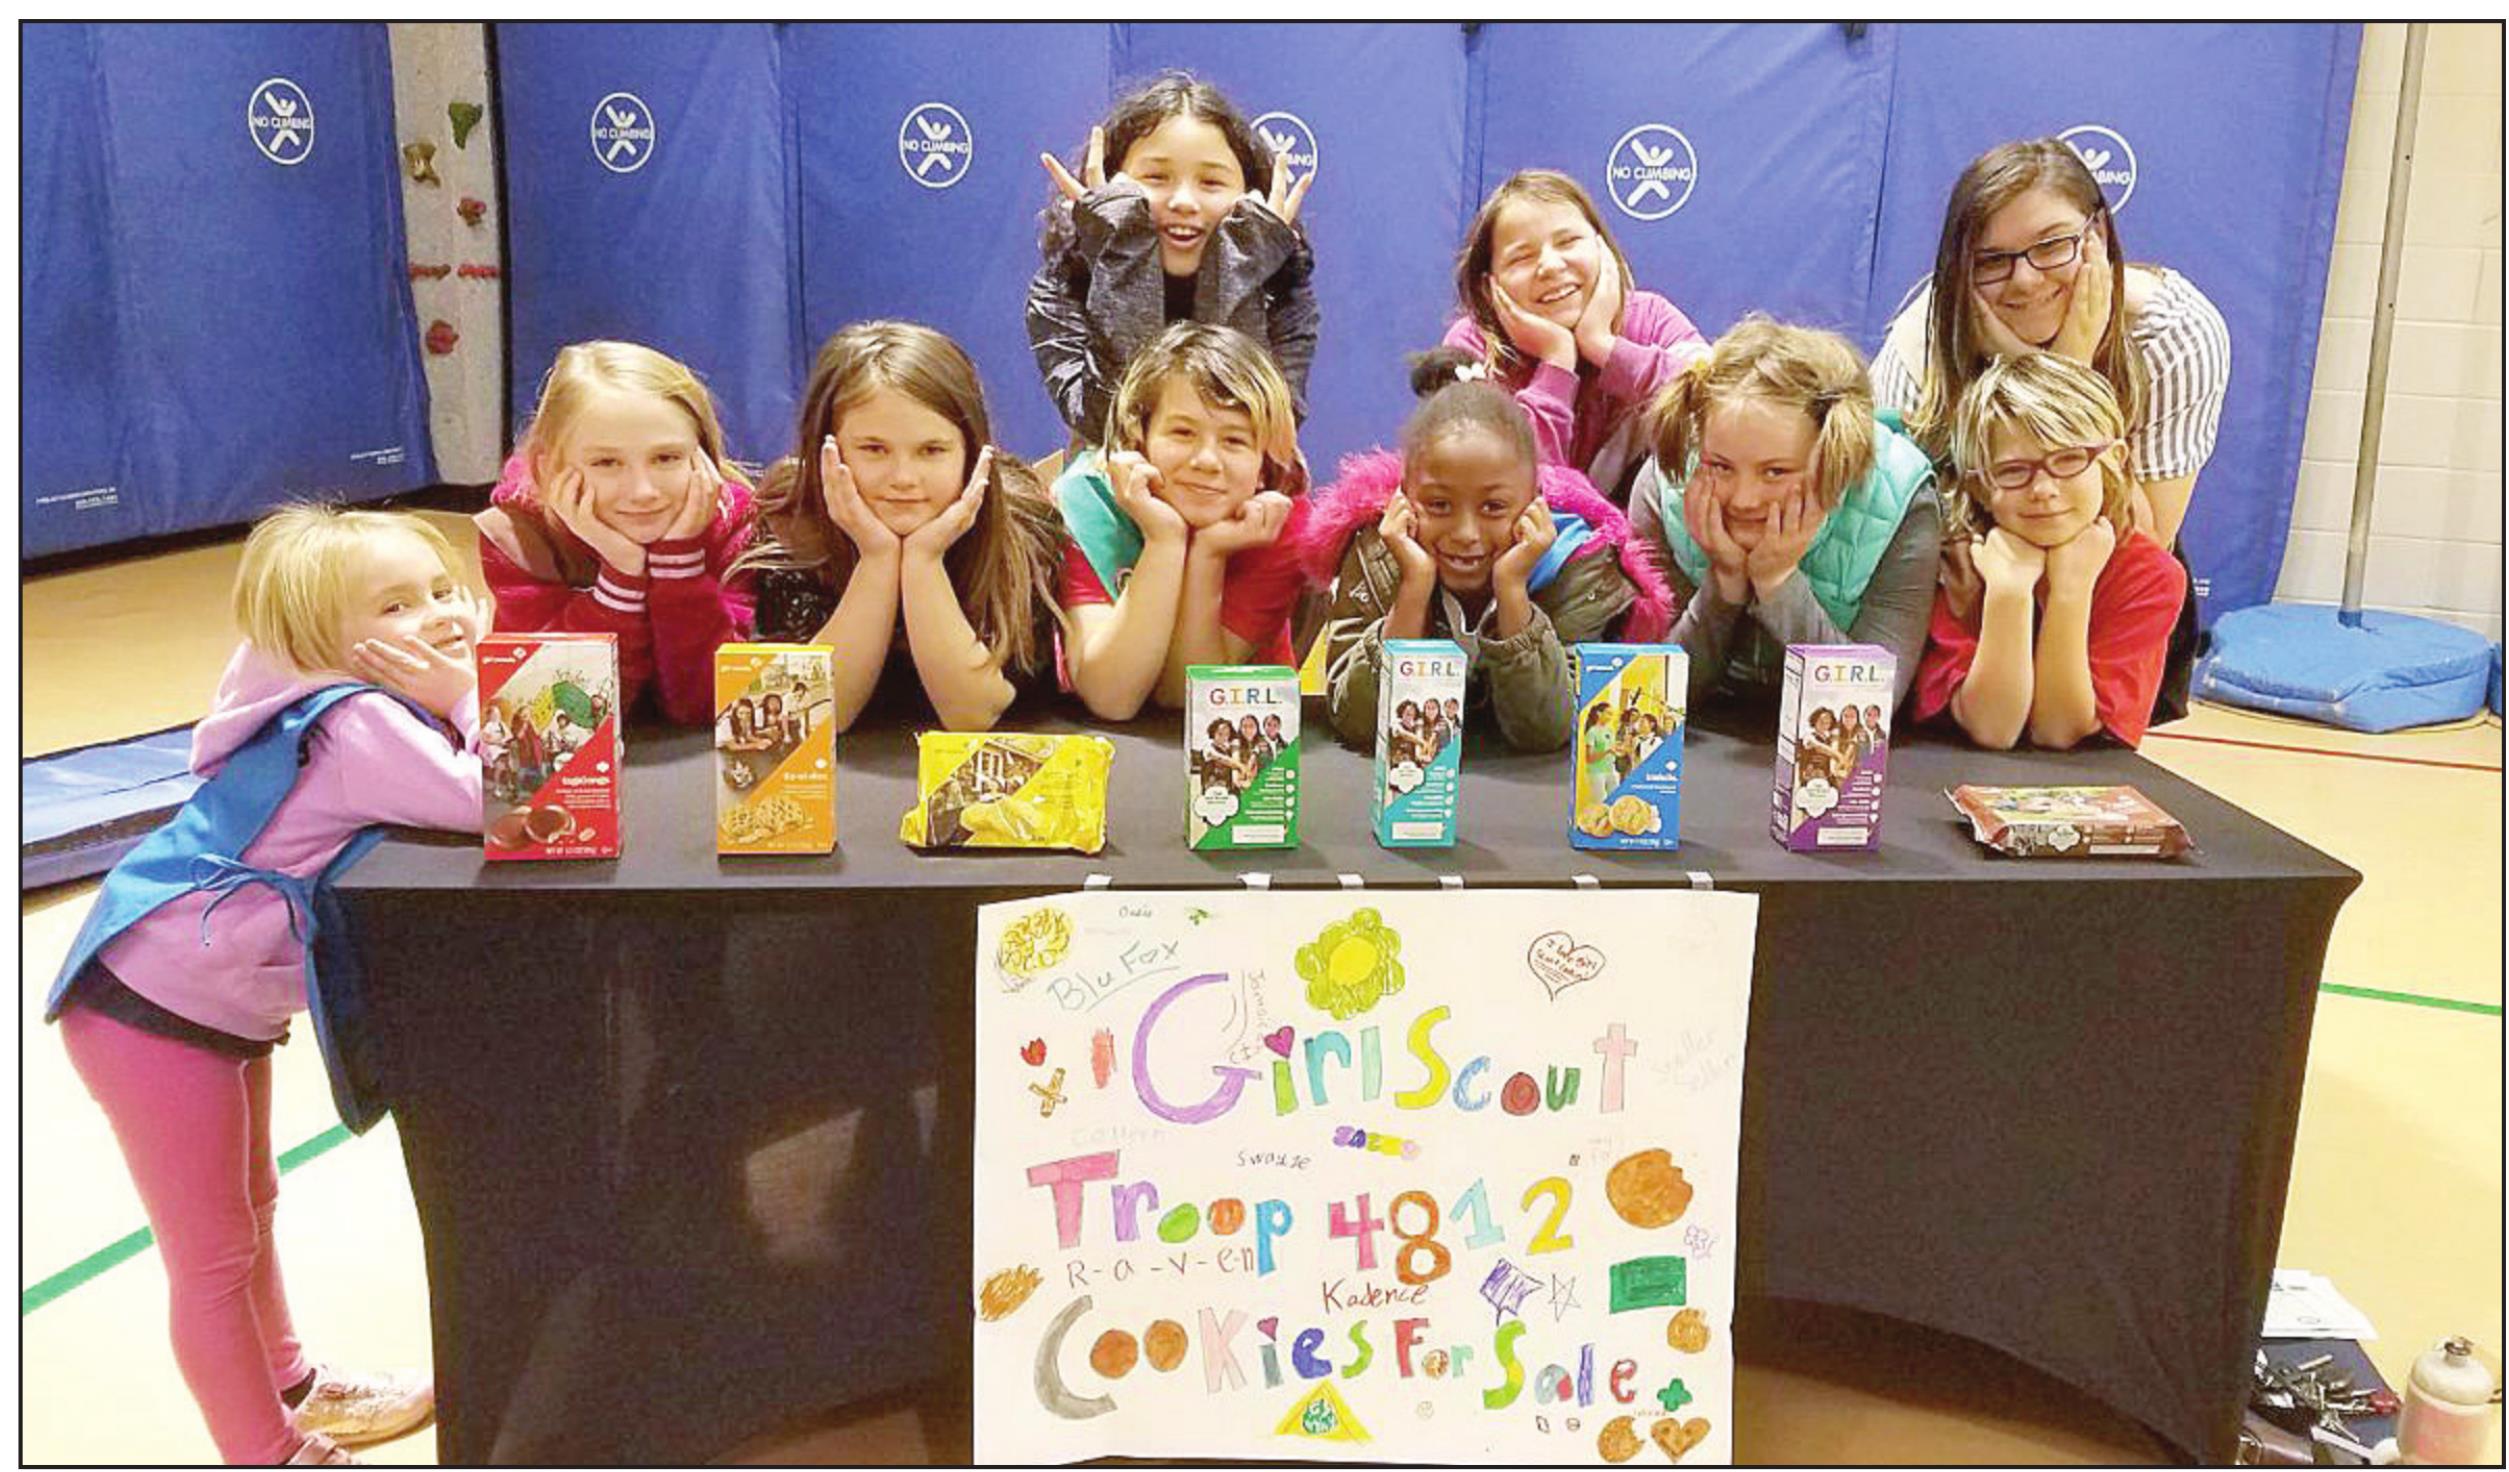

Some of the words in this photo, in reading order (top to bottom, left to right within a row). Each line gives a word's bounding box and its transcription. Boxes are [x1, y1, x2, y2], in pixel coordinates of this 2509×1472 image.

[253, 117, 269, 128] NO
[903, 140, 919, 151] NO
[921, 140, 968, 154] CLIMBING
[1613, 167, 1631, 179] NO
[1634, 167, 1691, 182] CLIMBING
[1132, 973, 1383, 1125] Girl
[1394, 1005, 1637, 1117] Scout
[1026, 1149, 1293, 1276] Troop
[1328, 1176, 1574, 1286] 4812
[1322, 1279, 1430, 1314] Kadence
[1393, 1317, 1474, 1379] For
[1483, 1318, 1638, 1410] Sale
